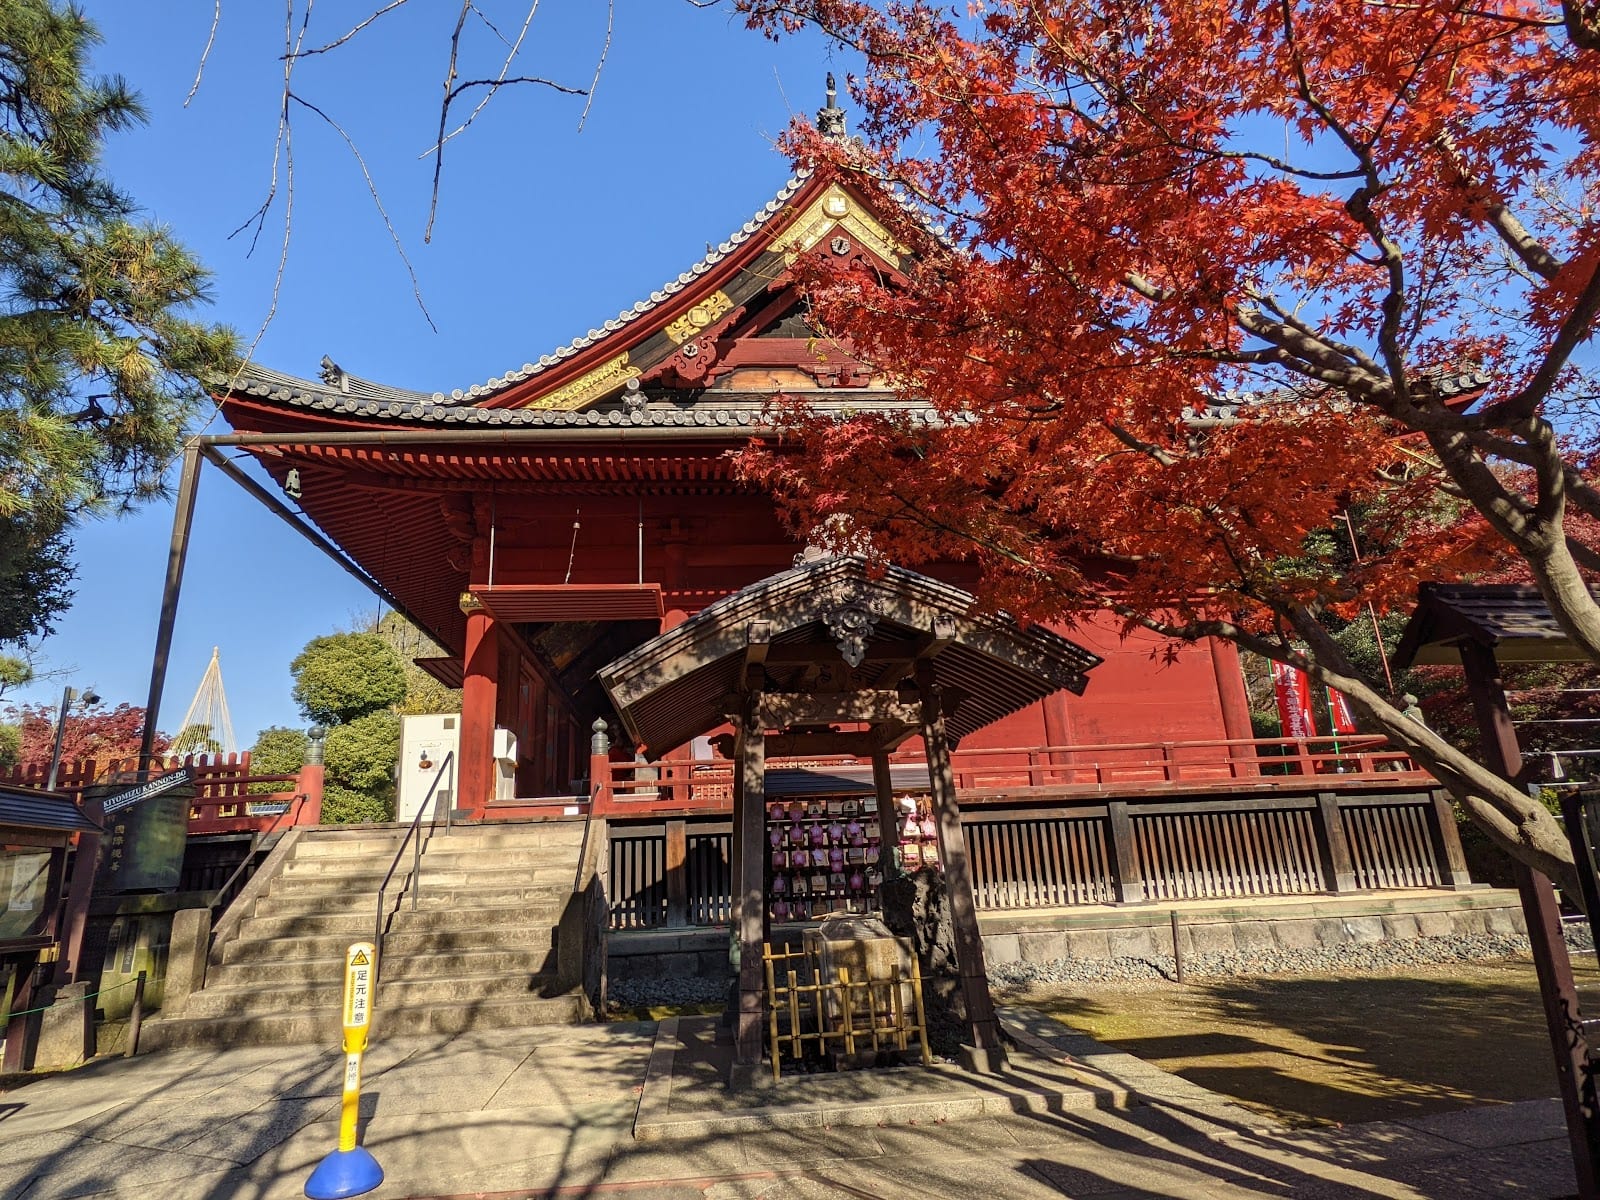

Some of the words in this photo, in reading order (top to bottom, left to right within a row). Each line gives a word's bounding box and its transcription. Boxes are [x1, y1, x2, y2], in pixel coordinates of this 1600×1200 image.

[103, 787, 142, 808] KIYOMIZU
[142, 769, 186, 793] KANNON-DO
[353, 970, 367, 1024] 足元注意
